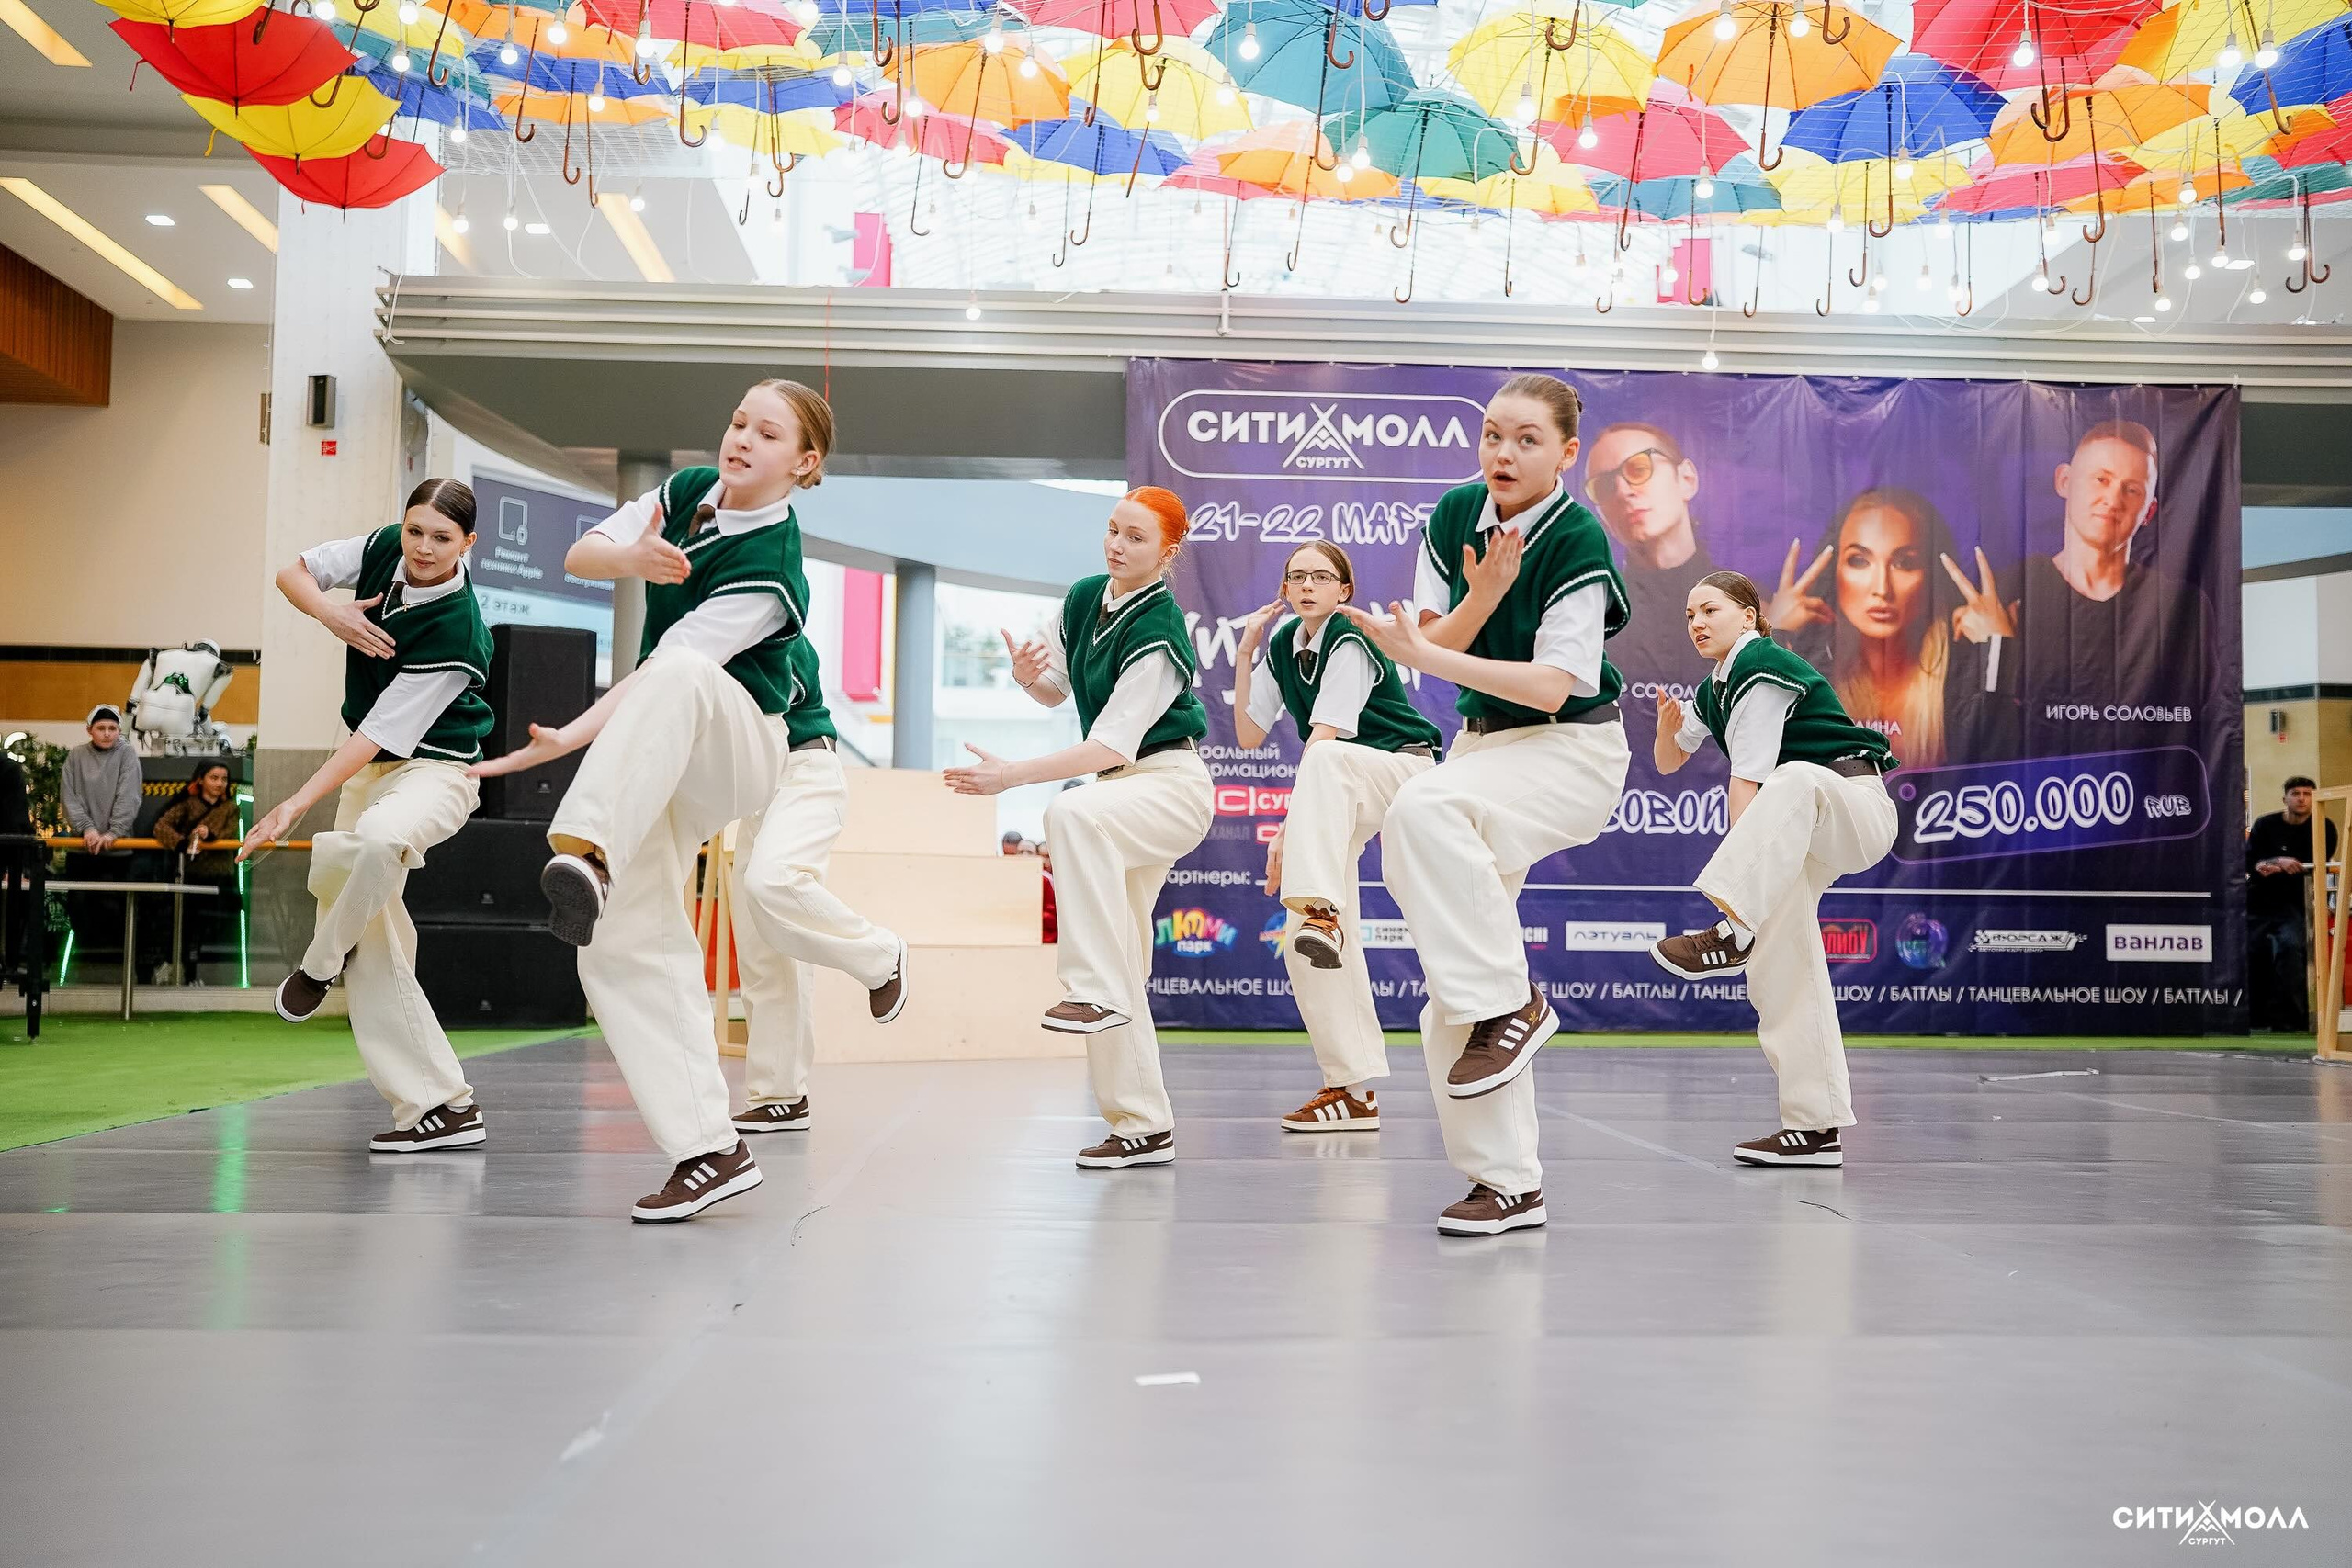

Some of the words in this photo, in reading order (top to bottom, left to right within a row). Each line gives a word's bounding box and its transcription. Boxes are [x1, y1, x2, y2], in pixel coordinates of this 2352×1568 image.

[1187, 410, 1306, 444] СИТИ
[1341, 413, 1470, 448] МОЛЛ
[1295, 456, 1351, 469] СУРГУТ
[1186, 501, 1325, 543] 21-22
[2045, 704, 2099, 721] ИГОРЬ
[2103, 705, 2192, 723] СОЛОВЬЕВ
[1913, 771, 2134, 844] 250.000
[2143, 795, 2192, 818] RUB
[2115, 935, 2203, 951] ванлав
[1551, 981, 1596, 999] ШОУ
[1968, 986, 2100, 1004] ТАНЦЕВАЛЬНОЕ
[2104, 987, 2149, 1005] ШОУ
